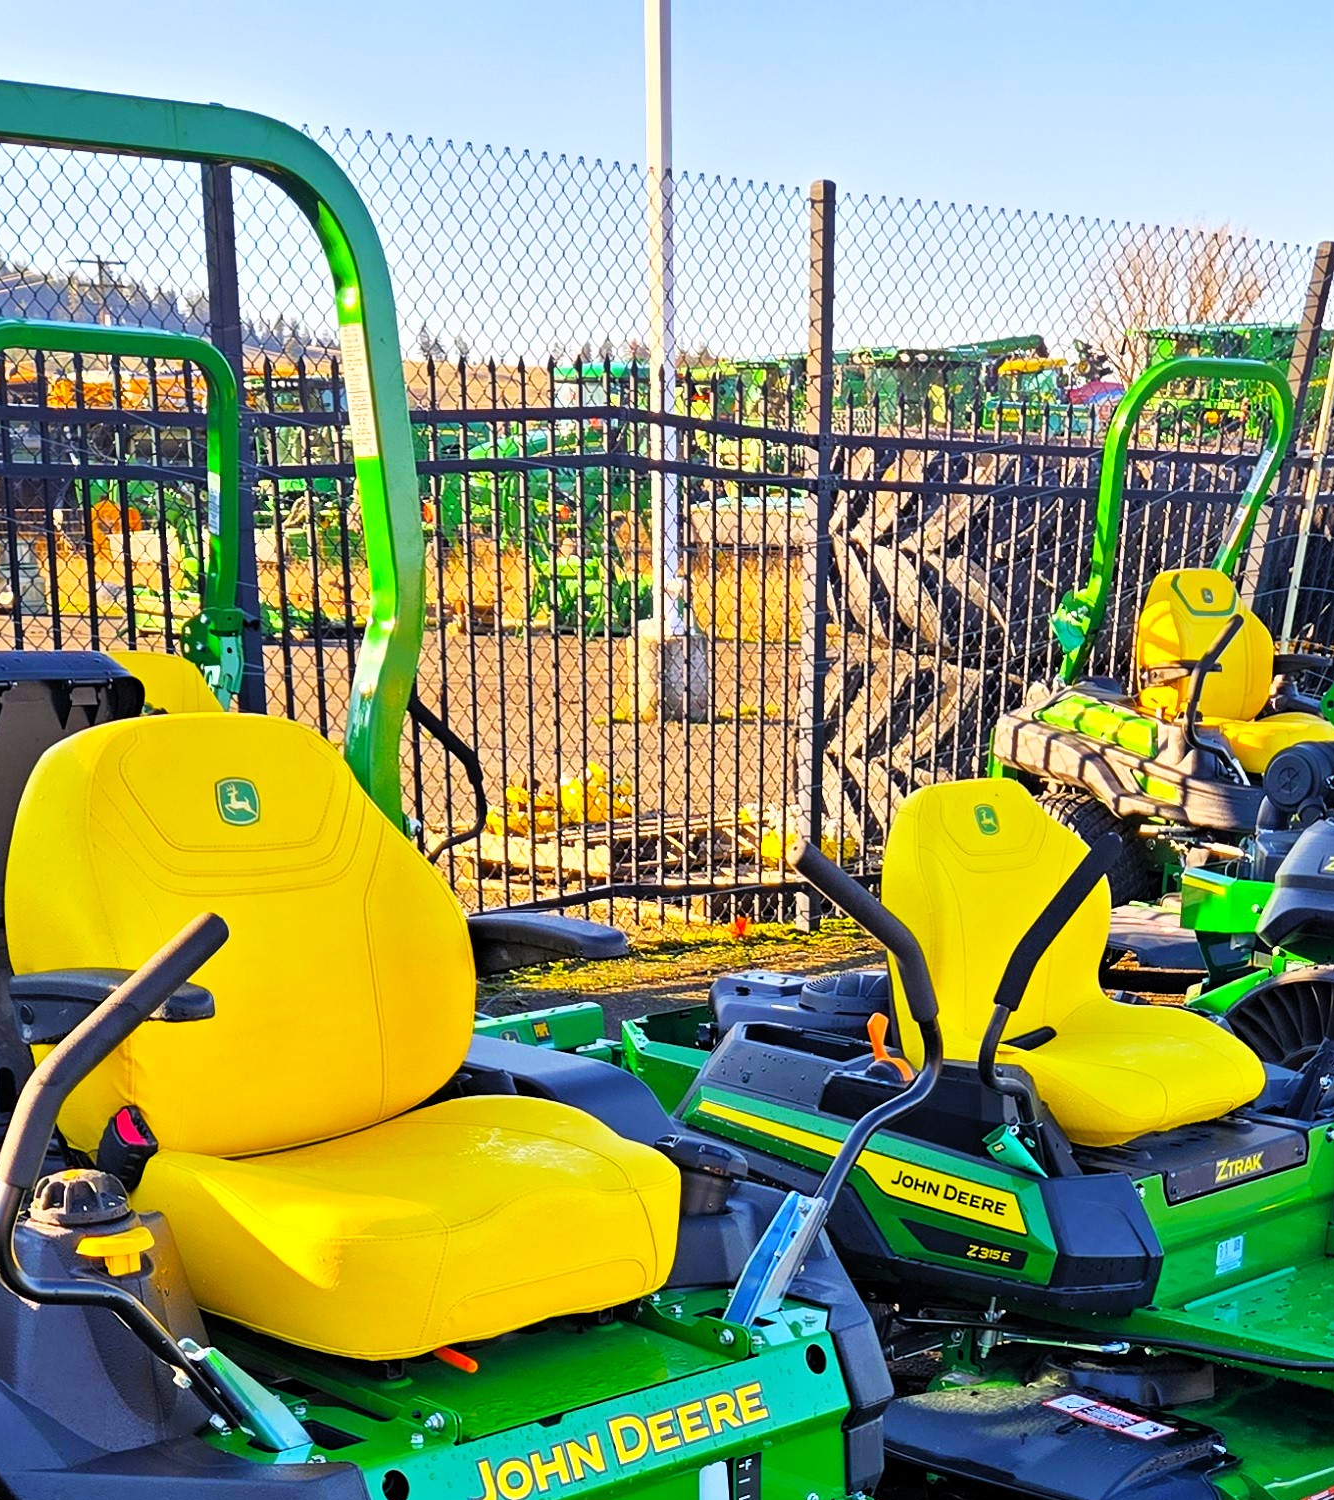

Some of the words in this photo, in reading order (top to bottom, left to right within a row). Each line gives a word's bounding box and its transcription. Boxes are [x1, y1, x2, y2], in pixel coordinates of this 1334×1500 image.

[1215, 1151, 1265, 1184] ZTRAK
[891, 1170, 940, 1197] JOHN
[943, 1184, 1007, 1216] DEERE
[608, 1381, 770, 1466] DEERE
